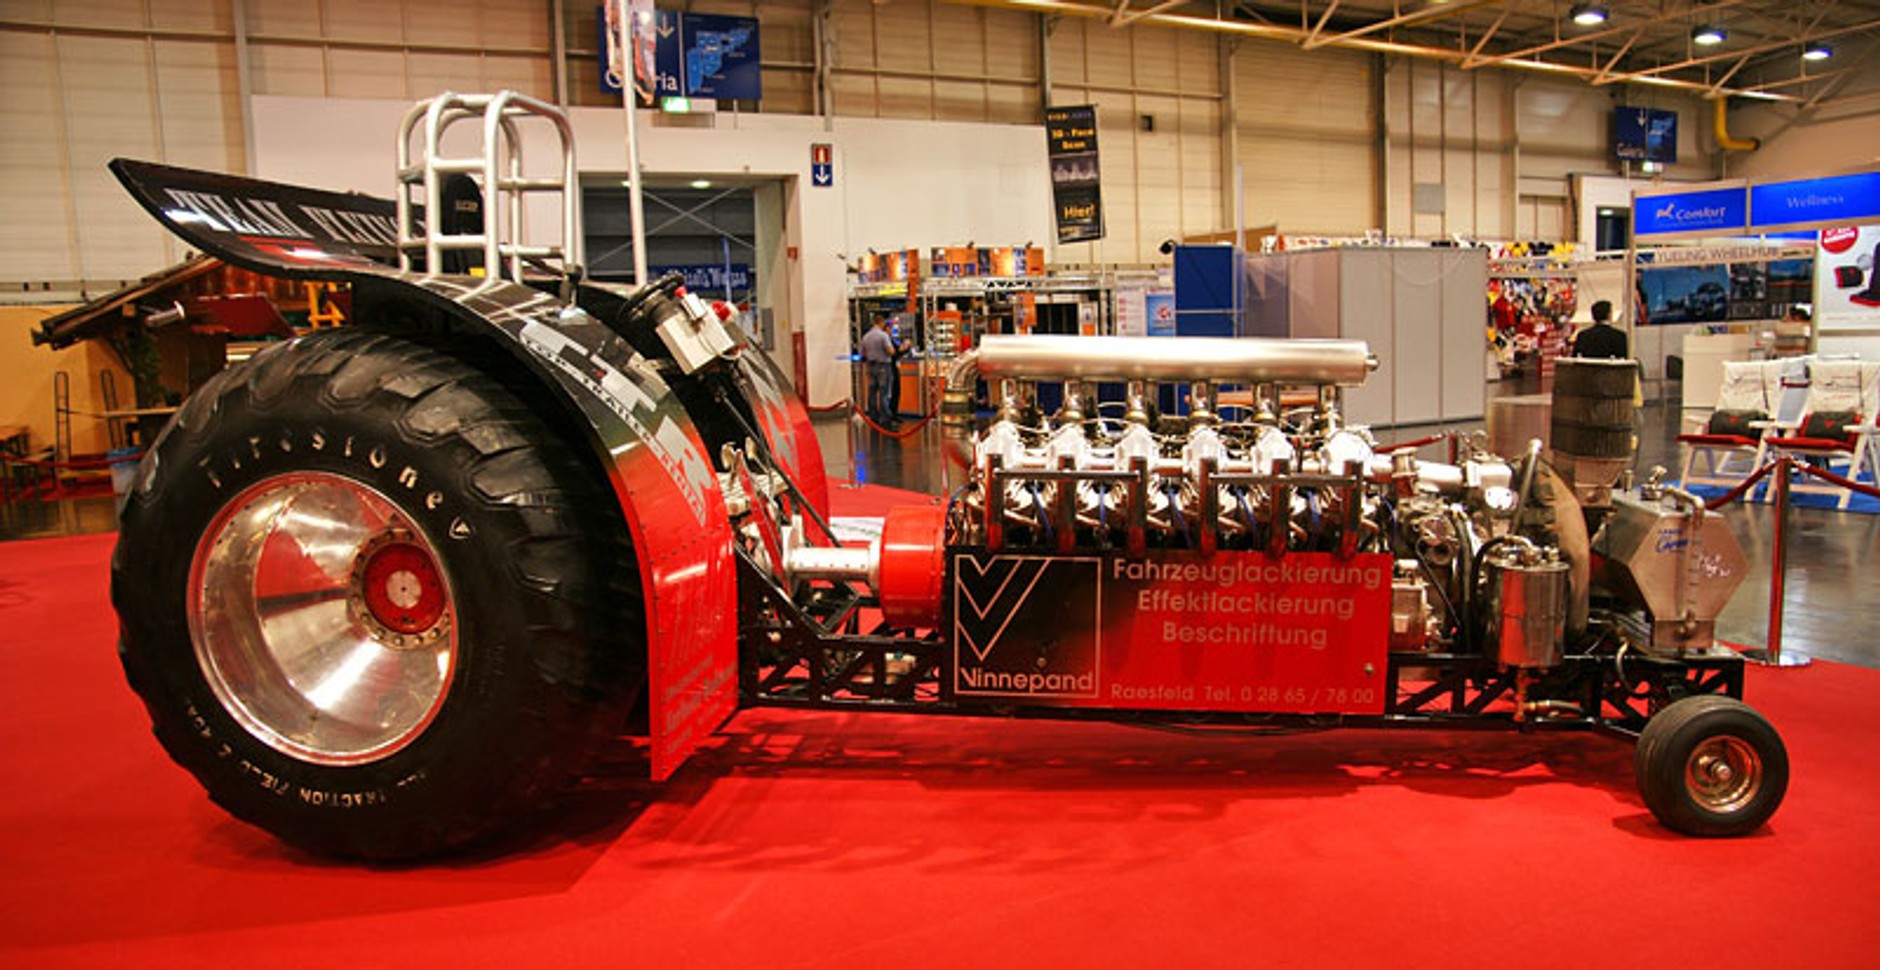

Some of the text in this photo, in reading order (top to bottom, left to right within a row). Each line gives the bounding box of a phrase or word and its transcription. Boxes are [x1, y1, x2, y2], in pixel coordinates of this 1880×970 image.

[1113, 558, 1382, 589] Fahrzeuglackierung
[1138, 590, 1355, 619] Effektlackierung
[1163, 621, 1328, 649] Beschriftung
[960, 667, 1093, 694] Vinnepand
[1111, 683, 1194, 701] Raesfeld
